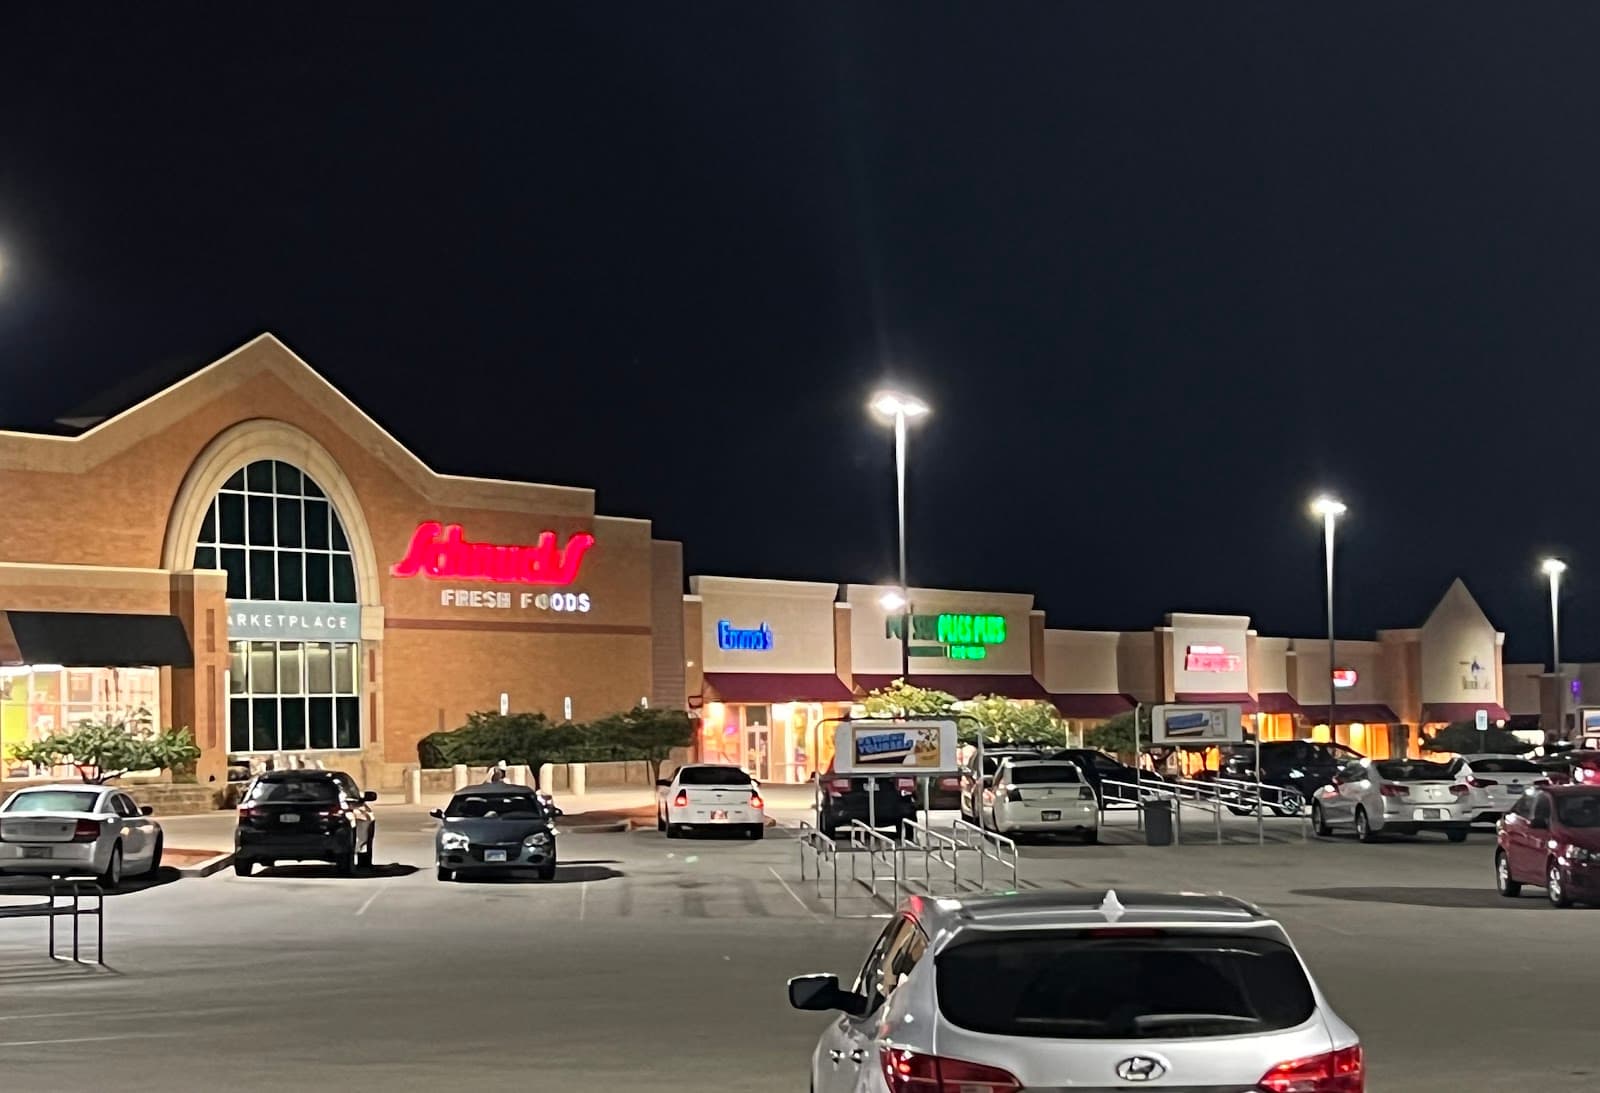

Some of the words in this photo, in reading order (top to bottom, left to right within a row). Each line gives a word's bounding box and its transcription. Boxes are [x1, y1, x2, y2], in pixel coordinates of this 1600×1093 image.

[441, 588, 511, 609] FRESH
[520, 592, 591, 613] FOODS
[227, 613, 348, 629] ARKETPLACE
